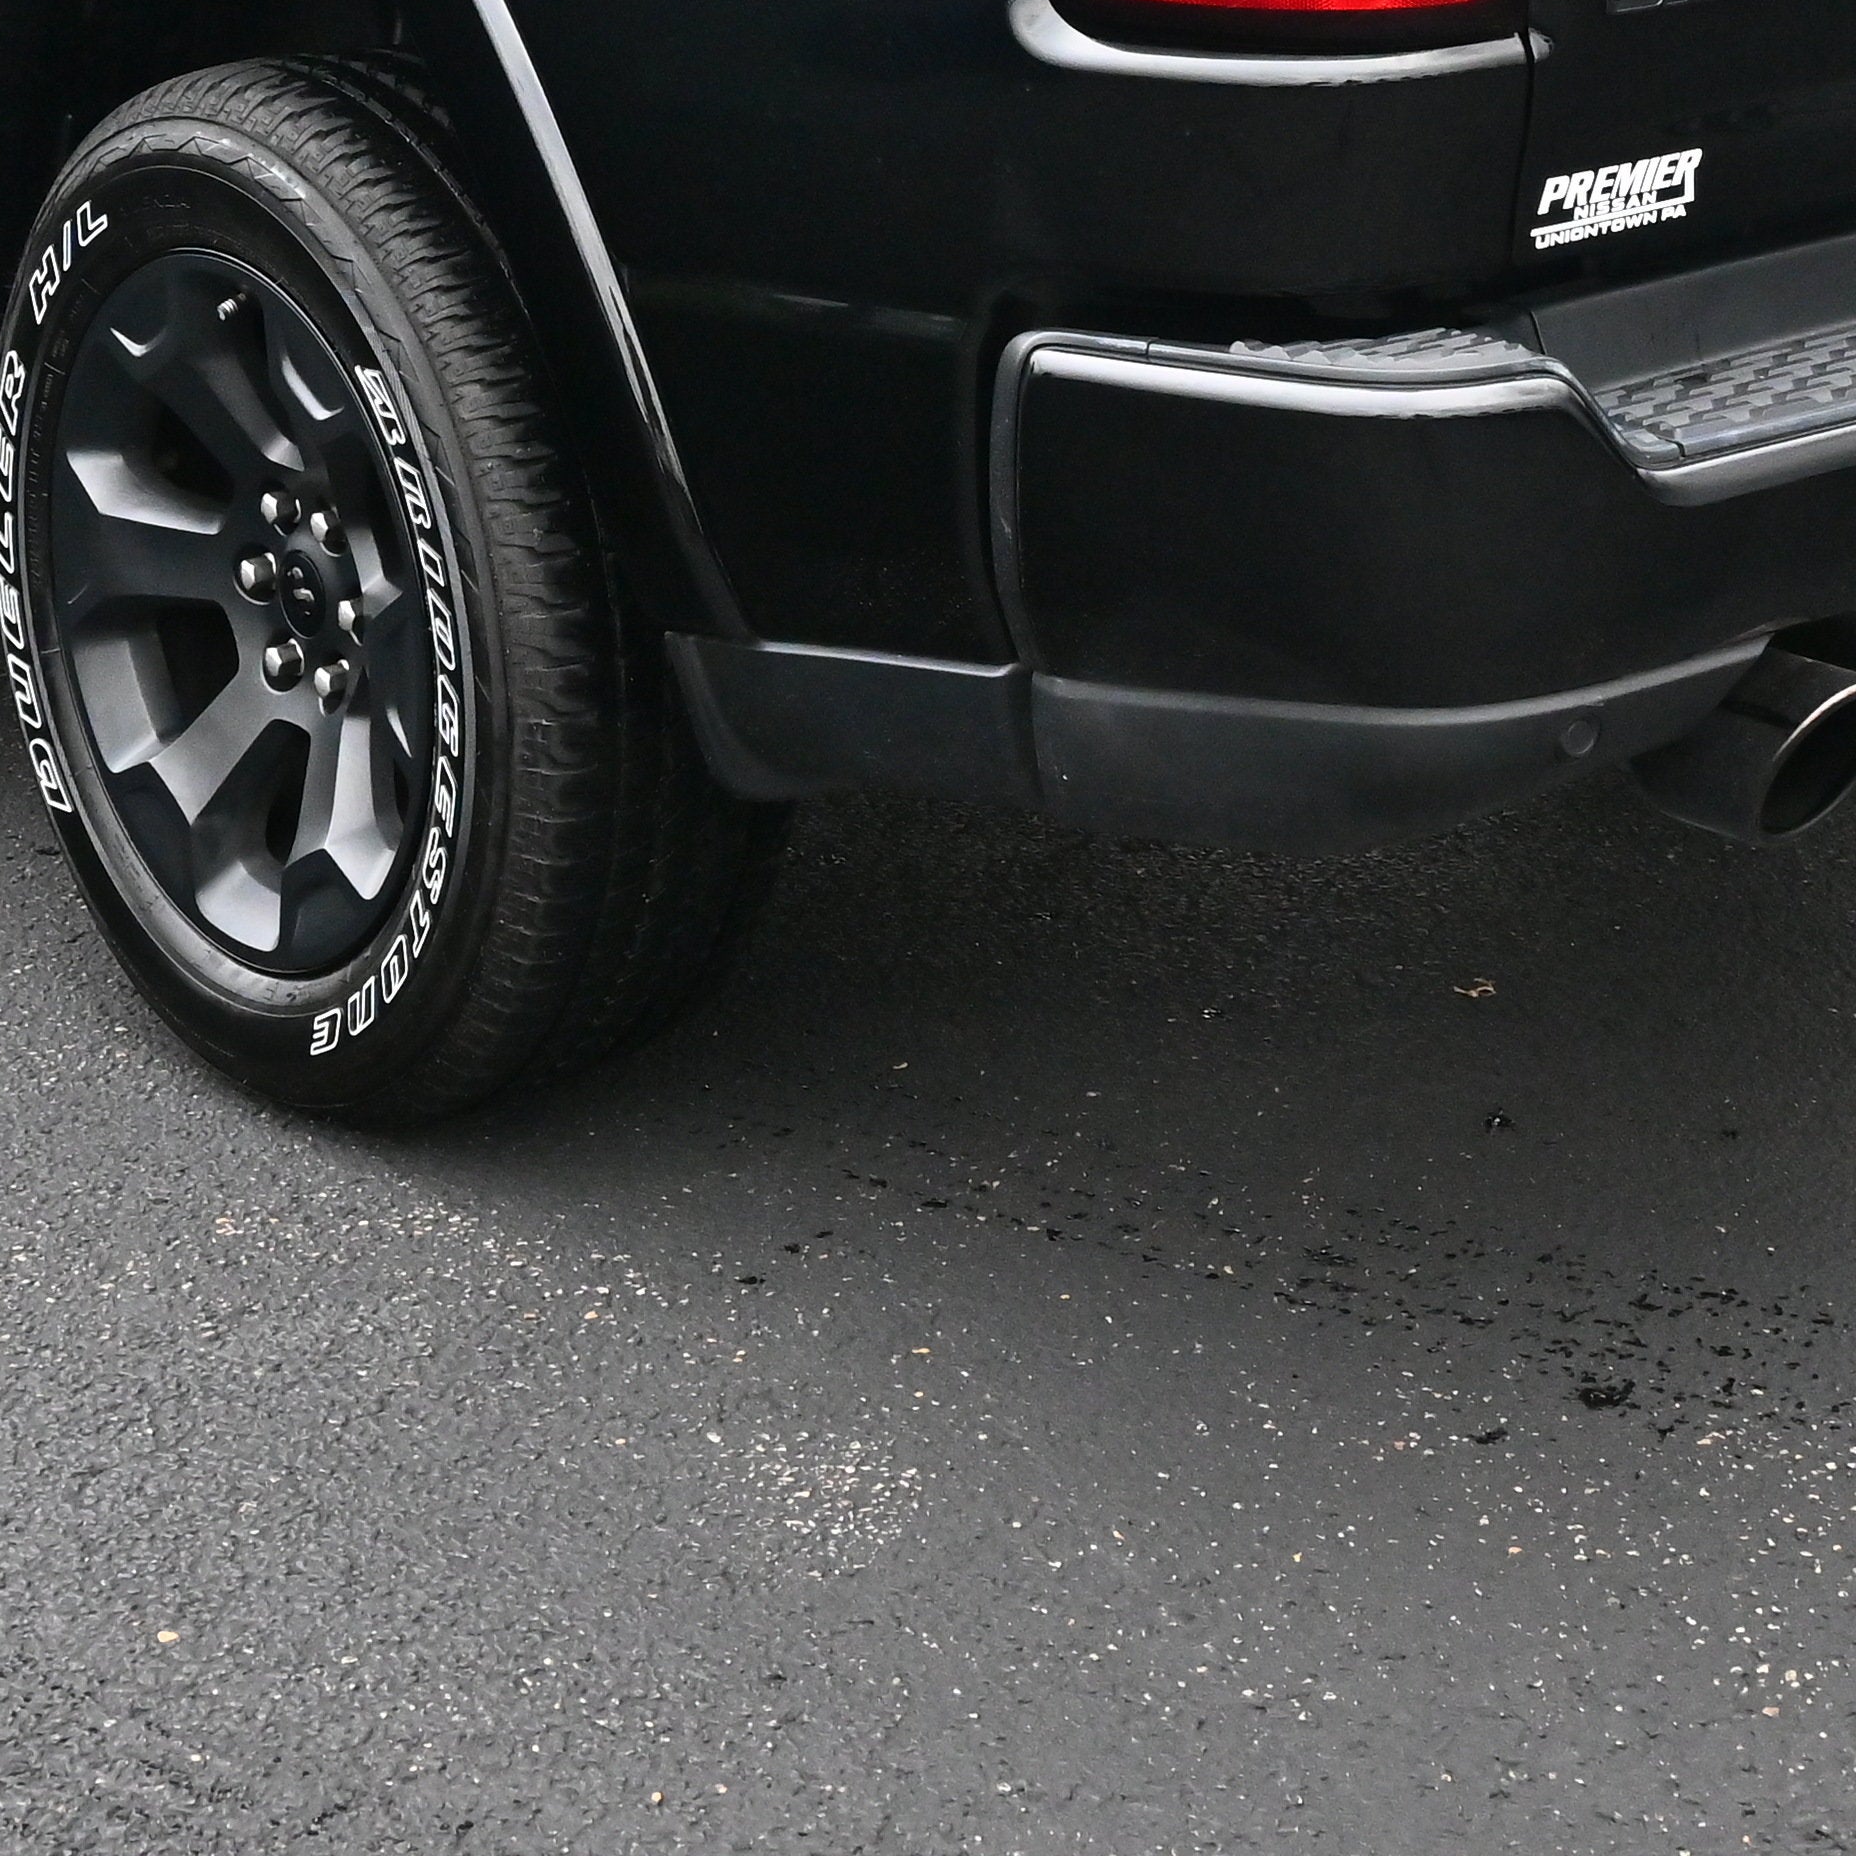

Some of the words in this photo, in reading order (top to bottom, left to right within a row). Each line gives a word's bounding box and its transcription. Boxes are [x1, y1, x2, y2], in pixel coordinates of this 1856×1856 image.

[1537, 148, 1703, 215] PREMIER
[1573, 190, 1658, 221] NISSAN
[1534, 209, 1658, 250] UNIONTOWN
[1660, 204, 1687, 221] PA
[309, 364, 460, 1056] BRIDGESTONE
